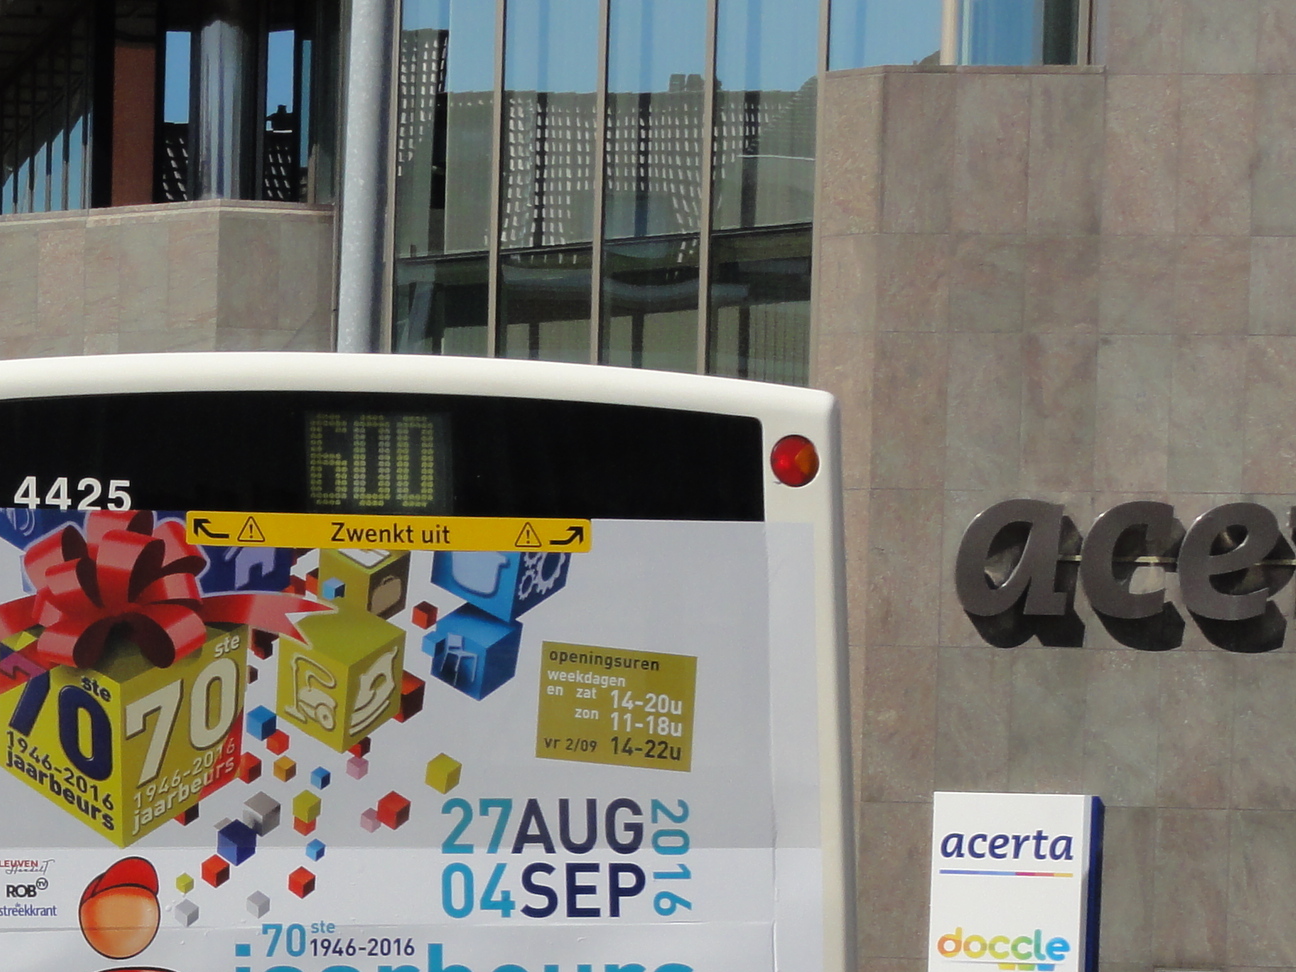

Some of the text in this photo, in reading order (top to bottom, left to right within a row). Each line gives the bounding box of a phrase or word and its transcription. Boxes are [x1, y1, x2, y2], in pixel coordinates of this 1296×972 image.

[310, 414, 433, 507] 600
[13, 475, 132, 511] 4425
[330, 522, 451, 545] Zwenkt uit
[956, 499, 1296, 620] ace
[549, 650, 660, 671] openingsuren
[547, 670, 626, 688] weekdagen
[546, 685, 682, 715] en zat 14-20u
[574, 708, 682, 737] zon 11-18u
[544, 736, 682, 761] vr 2/09 14-22u
[6, 730, 114, 811] 1946-2016
[133, 736, 235, 809] 1946-2016
[6, 745, 115, 831] jaarbeurs
[131, 757, 235, 835] jaarbeurs
[650, 799, 692, 917] 2016
[940, 830, 1074, 861] acerta
[6, 884, 37, 898] ROB
[309, 937, 415, 957] 1946-2016
[937, 927, 1070, 961] doccle
